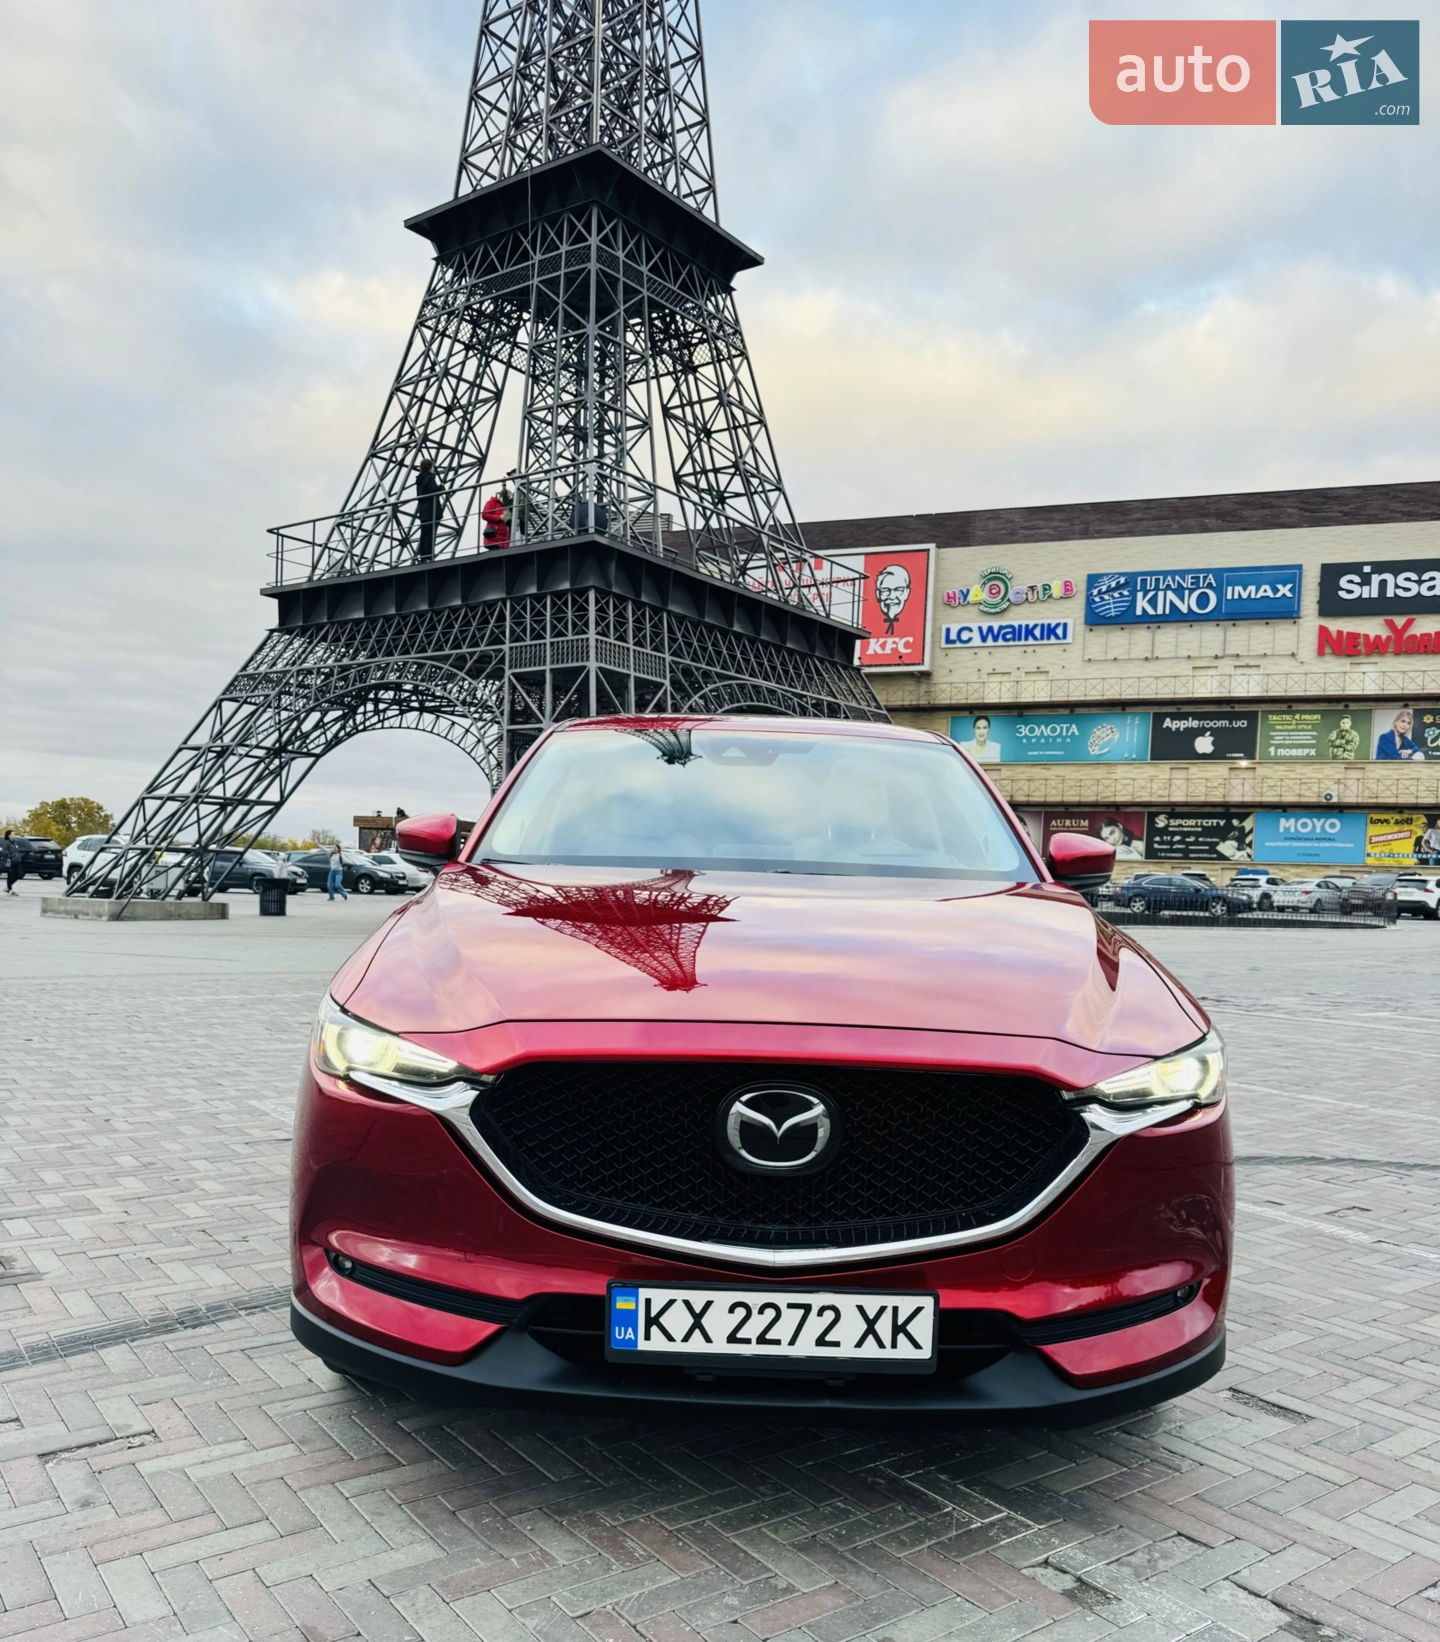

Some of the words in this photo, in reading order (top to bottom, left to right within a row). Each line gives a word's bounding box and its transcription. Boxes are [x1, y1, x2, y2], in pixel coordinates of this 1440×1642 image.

[1226, 583, 1294, 600] IMAX
[1135, 589, 1218, 616] KINO
[944, 626, 974, 645] LC
[866, 636, 914, 655] KFC
[1015, 723, 1080, 737] ЗОЛОТА
[1162, 716, 1248, 732] Appleroom.ua
[1268, 746, 1275, 757] 1
[1277, 748, 1317, 757] ПОВЕРХ
[1050, 819, 1089, 827] AURUM
[1168, 819, 1226, 827] SPORTCITY
[1279, 817, 1341, 834] MOYO
[643, 1297, 715, 1344] KX
[726, 1301, 842, 1348] 2272
[853, 1304, 926, 1350] XK
[615, 1327, 635, 1341] UA
